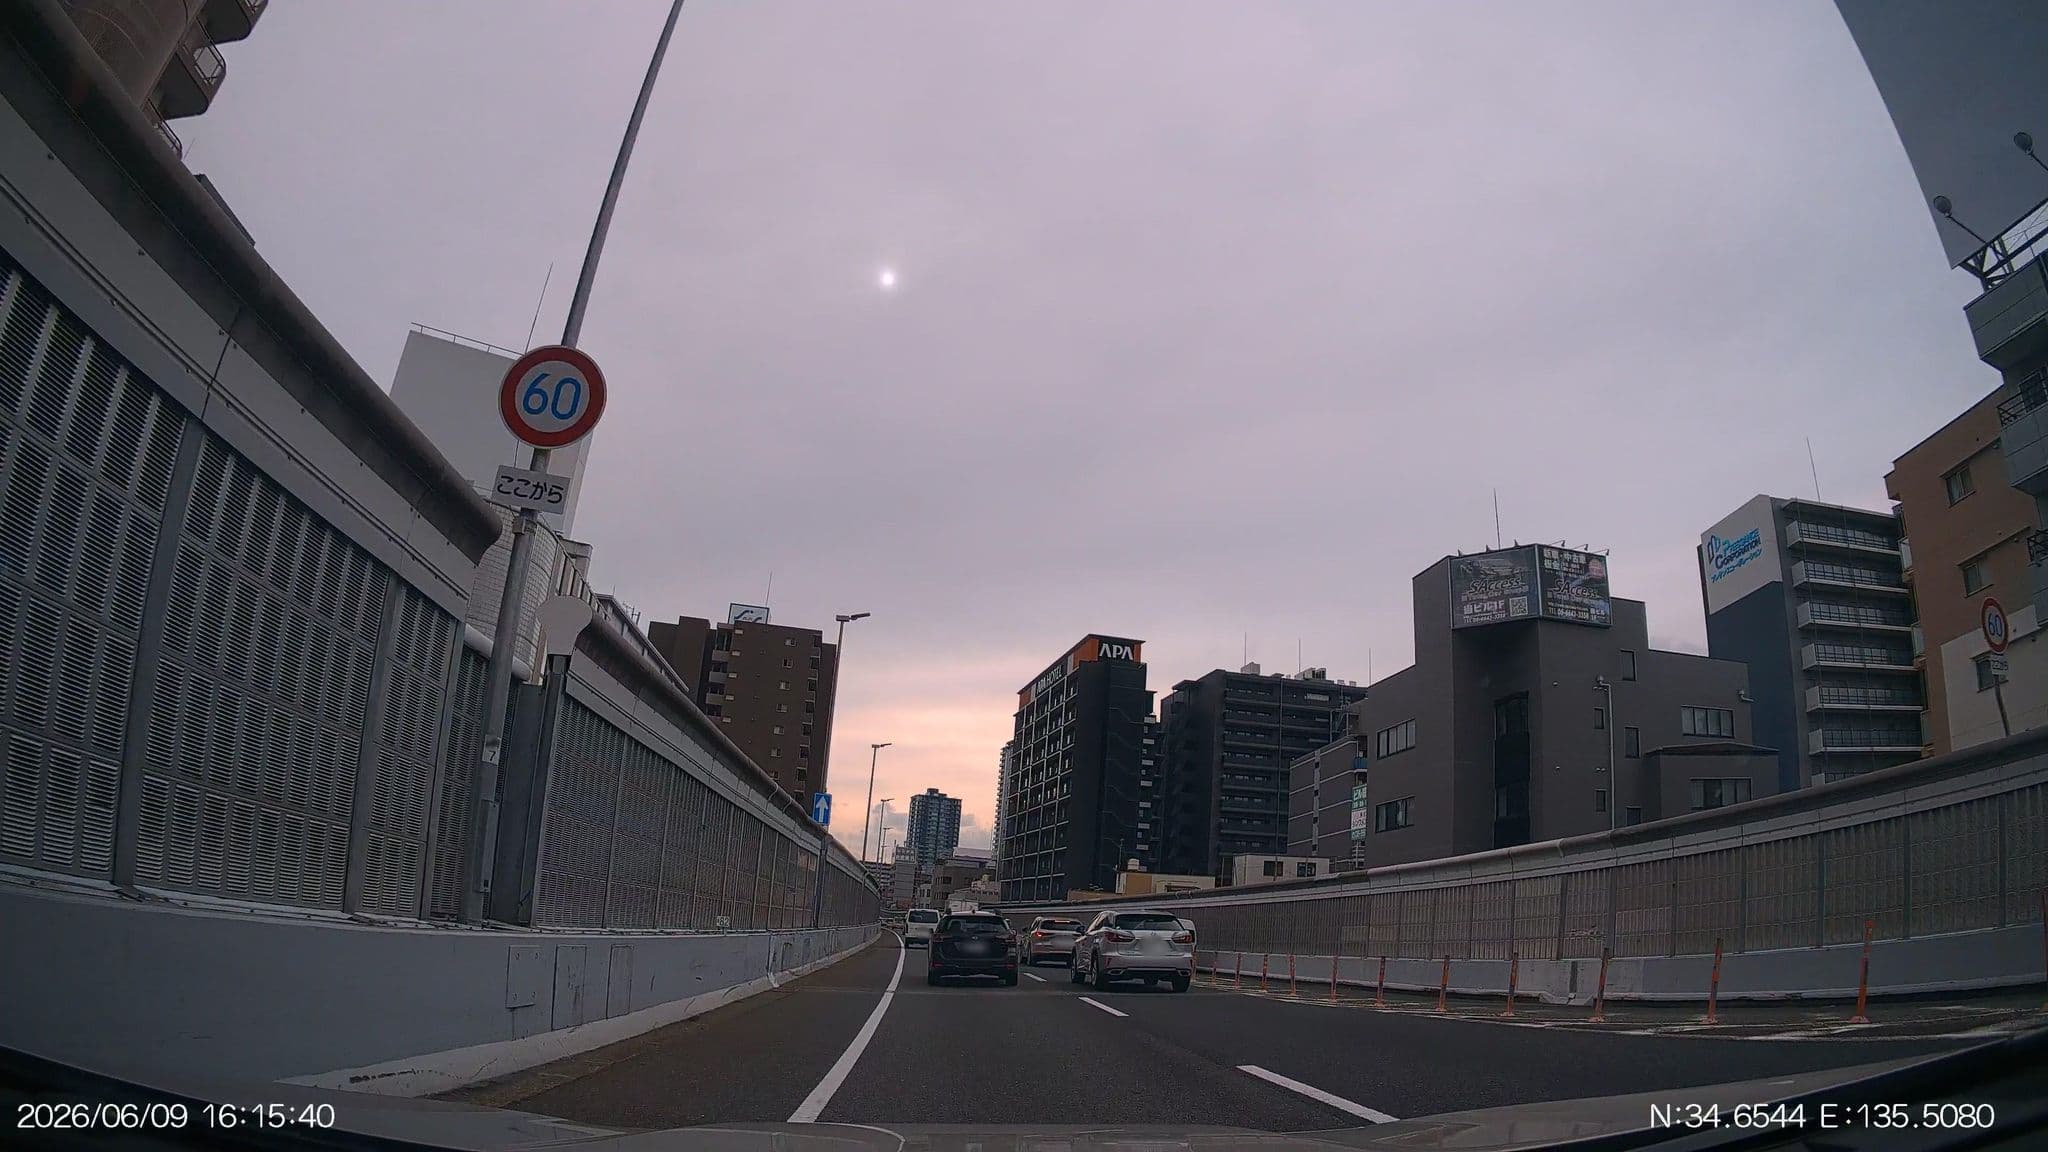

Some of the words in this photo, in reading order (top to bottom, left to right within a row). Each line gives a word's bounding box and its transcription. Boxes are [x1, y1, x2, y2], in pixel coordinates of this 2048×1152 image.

[522, 373, 582, 420] 60
[497, 475, 564, 504] ここから
[1988, 613, 2003, 637] 60
[1100, 643, 1133, 660] APA
[489, 750, 497, 762] 7
